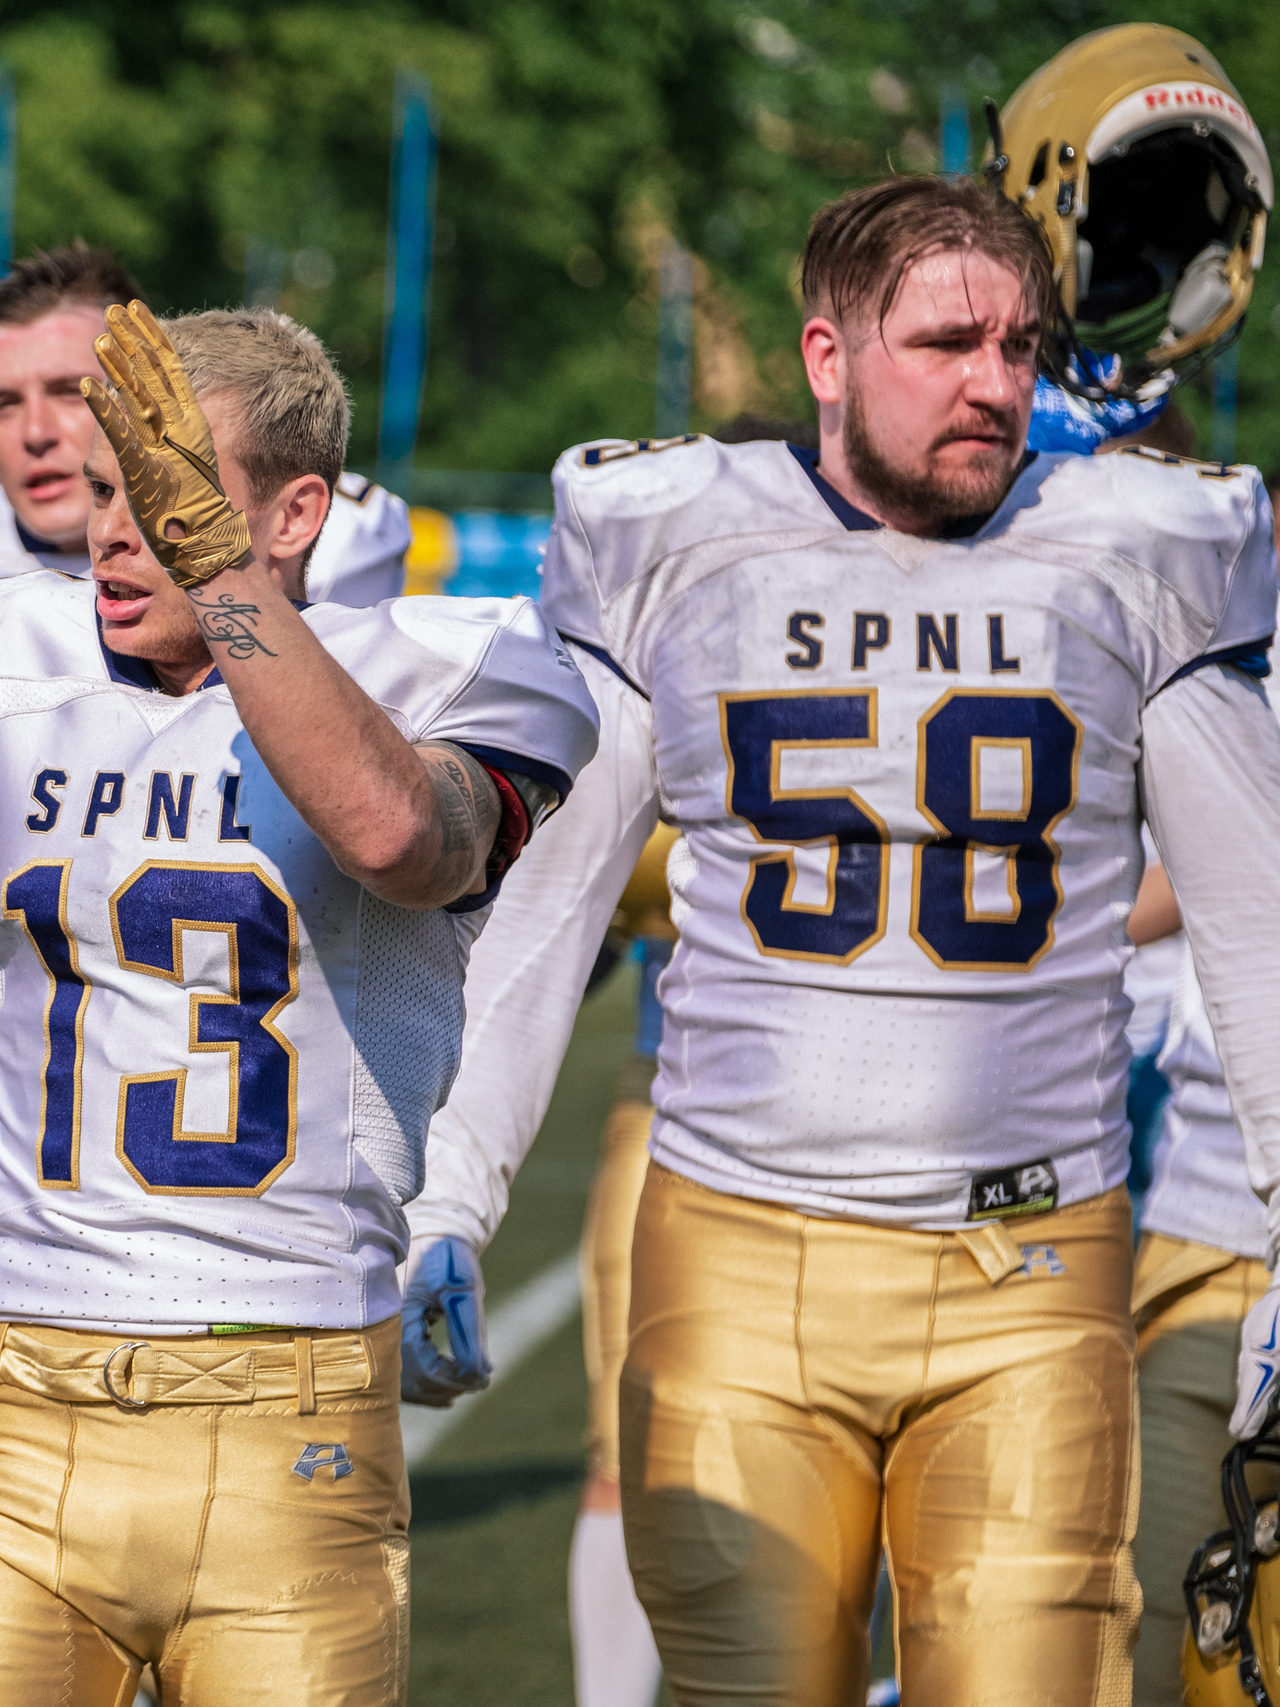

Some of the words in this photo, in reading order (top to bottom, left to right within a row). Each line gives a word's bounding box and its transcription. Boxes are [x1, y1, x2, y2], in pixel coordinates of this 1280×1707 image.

[786, 612, 1020, 671] SPNL
[26, 768, 251, 842] SPNL
[719, 688, 1085, 972] 58
[2, 858, 299, 1195] 13
[983, 1183, 1013, 1208] XL
